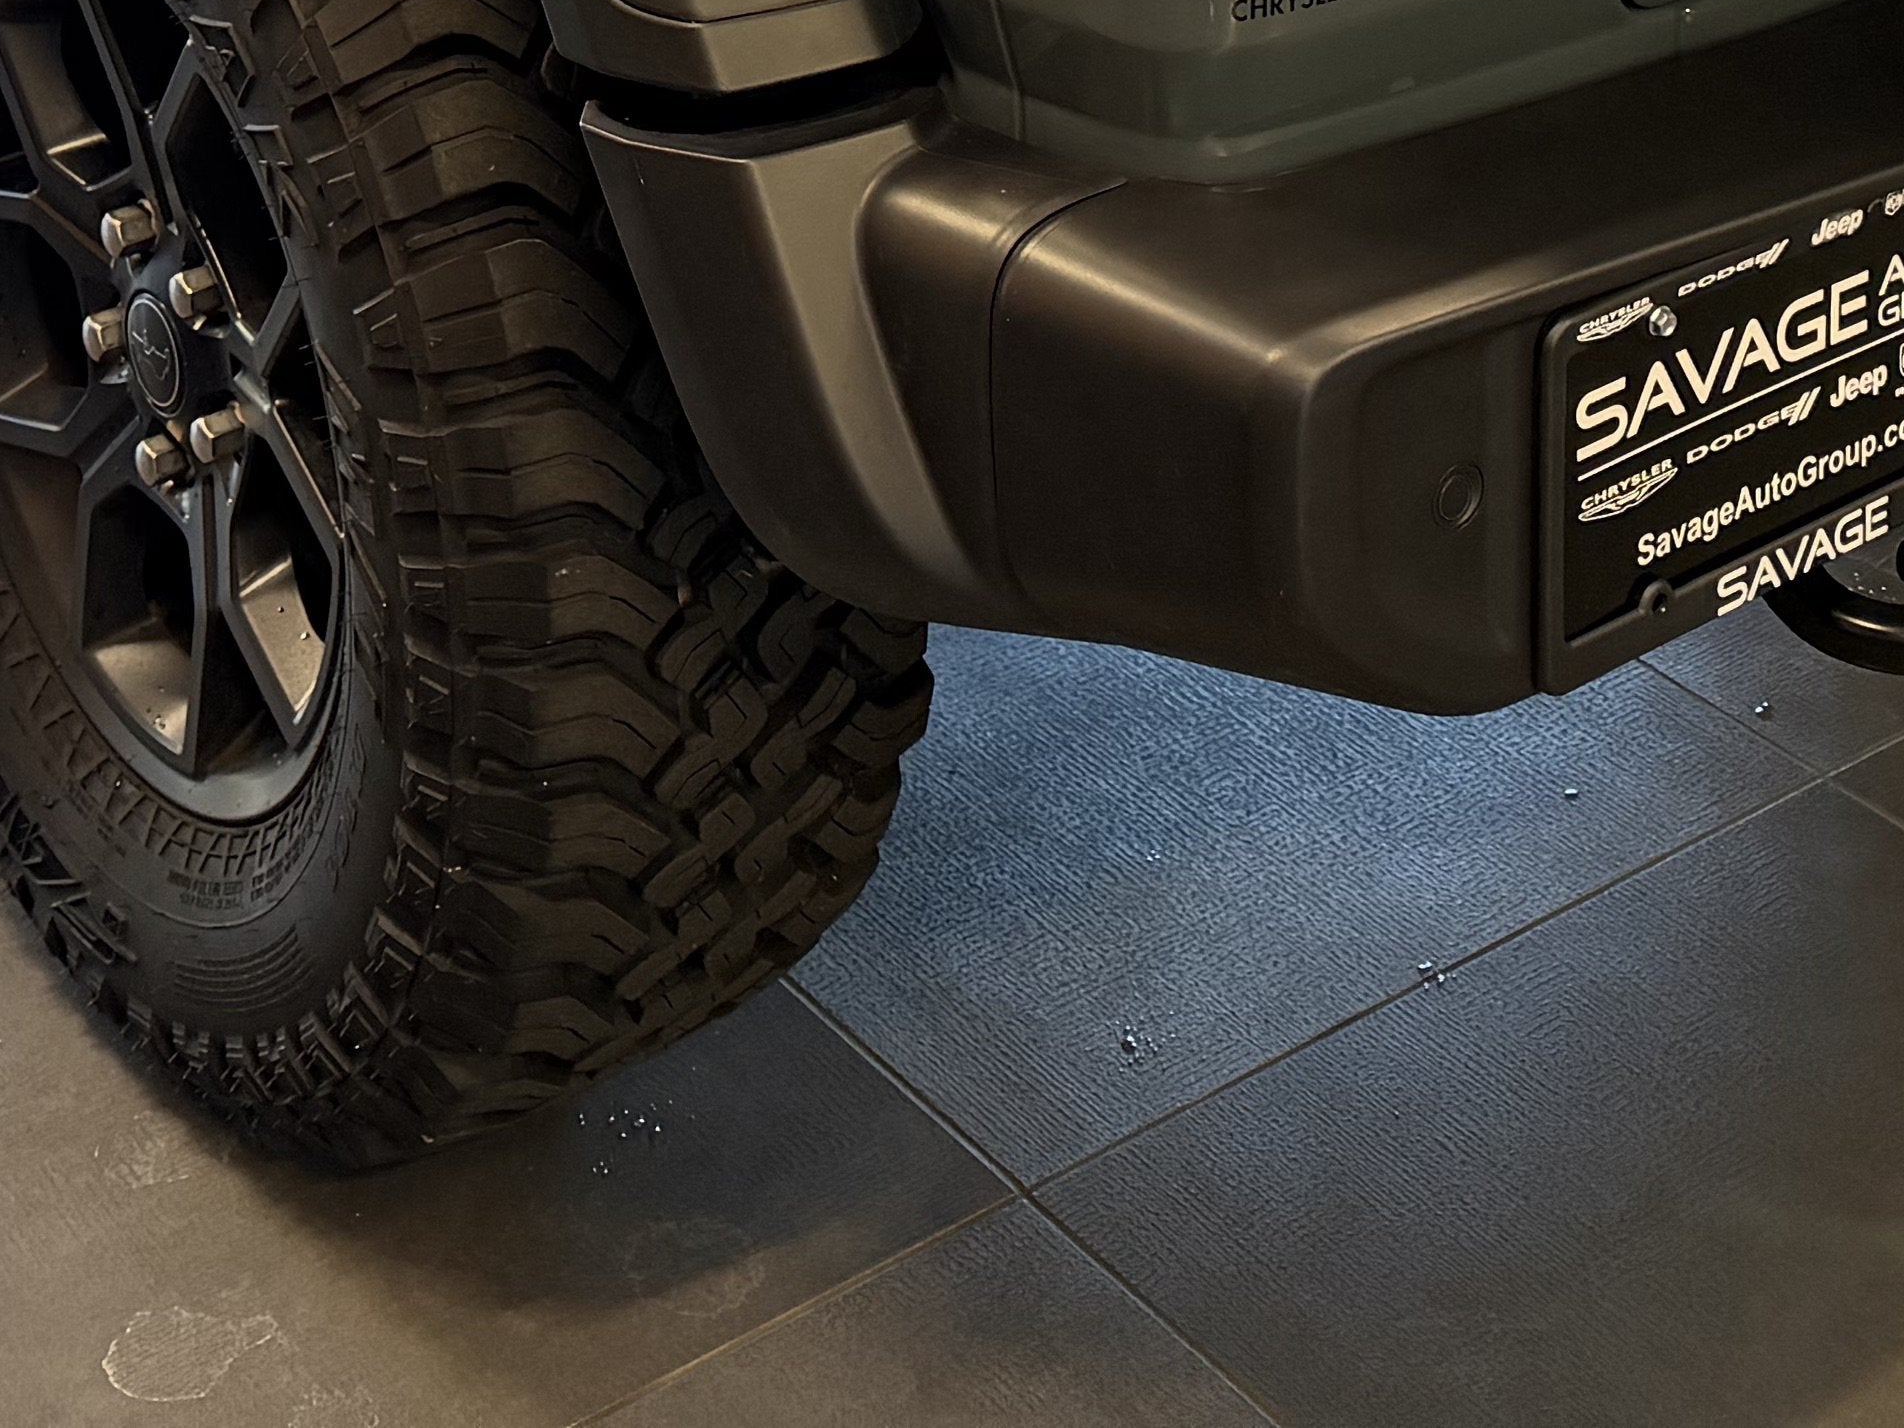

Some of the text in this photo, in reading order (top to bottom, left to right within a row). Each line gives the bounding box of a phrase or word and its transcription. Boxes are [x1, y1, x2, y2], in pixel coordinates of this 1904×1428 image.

[1677, 249, 1776, 297] DODGE
[1811, 209, 1863, 246] Jeep
[1576, 270, 1869, 462] SAVAGE
[1581, 459, 1673, 510] CHRYSLER
[1686, 406, 1799, 464] DODGE
[1830, 365, 1888, 408] Jeep
[1716, 495, 1889, 617] SAVAGE
